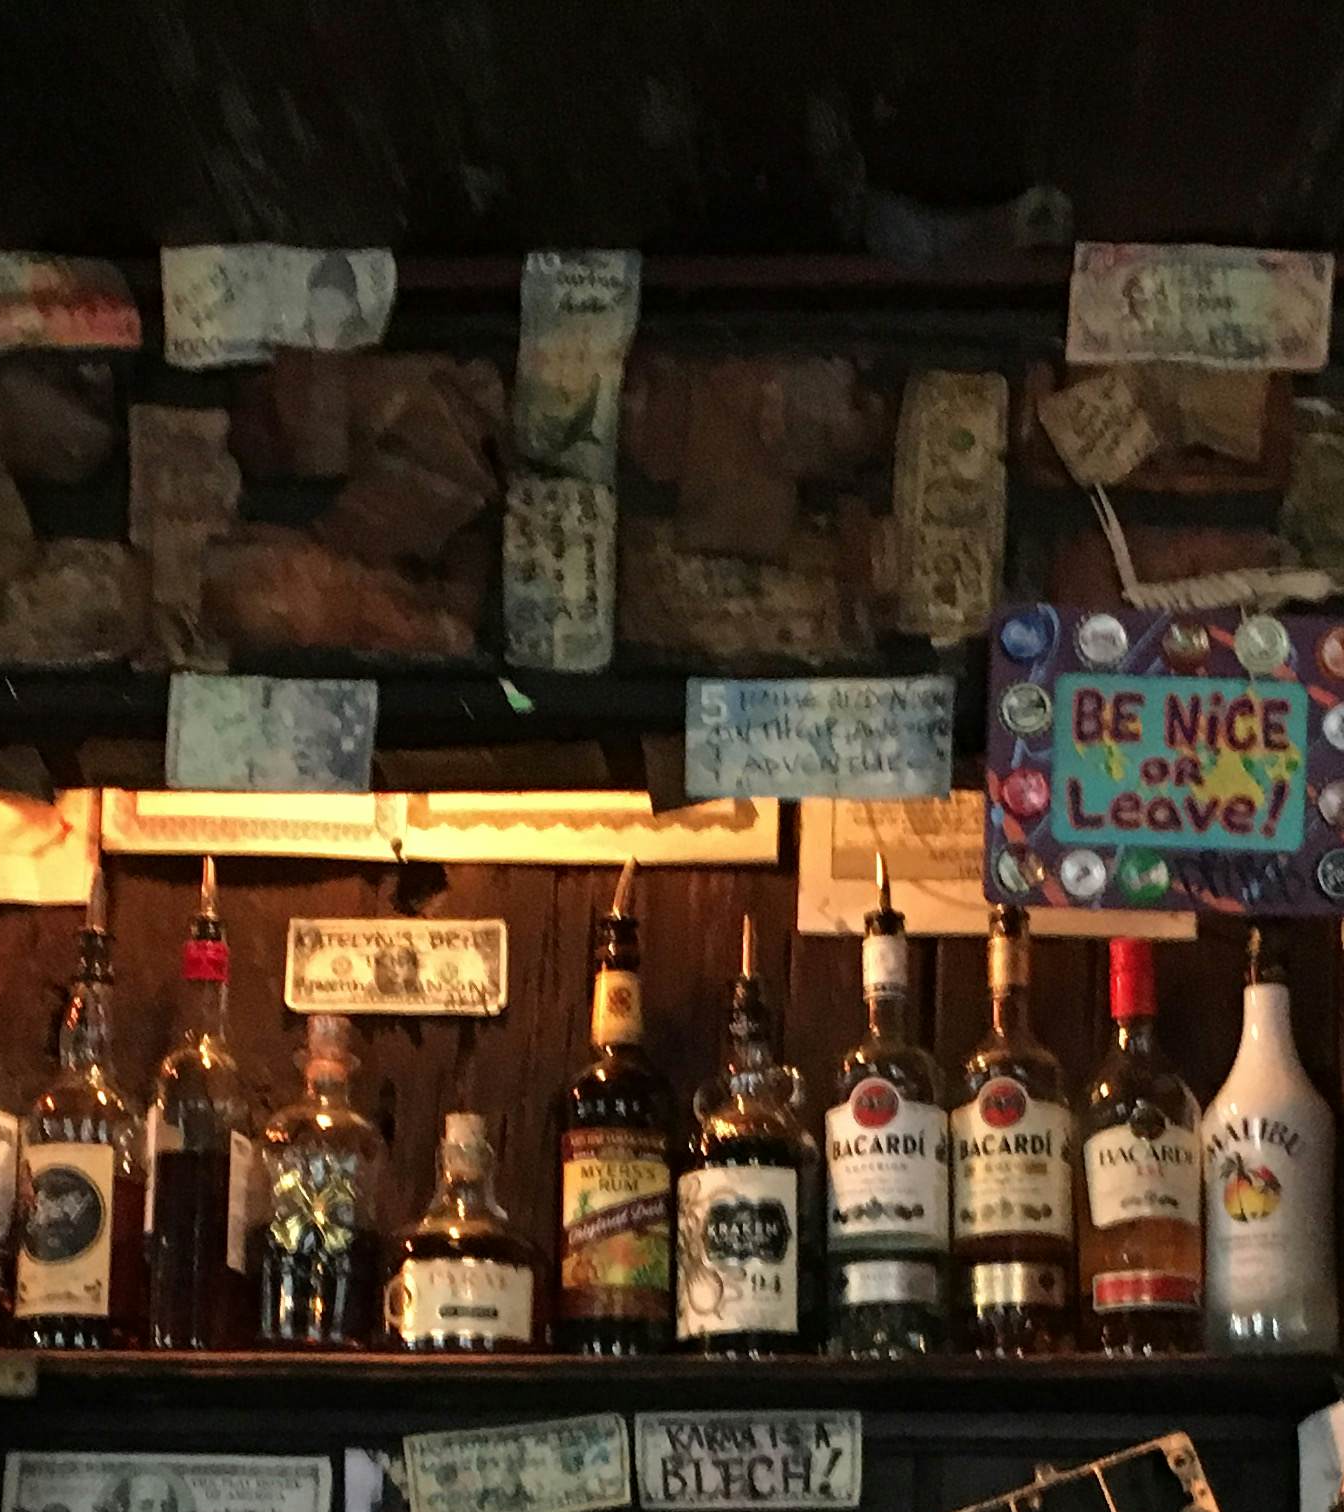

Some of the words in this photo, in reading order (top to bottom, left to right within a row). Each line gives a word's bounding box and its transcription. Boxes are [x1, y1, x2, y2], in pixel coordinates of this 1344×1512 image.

[1073, 688, 1145, 743] BE
[1067, 778, 1289, 839] Leave!
[1206, 1115, 1306, 1164] MALIBU
[598, 1178, 640, 1193] RUM
[814, 1421, 830, 1449] A
